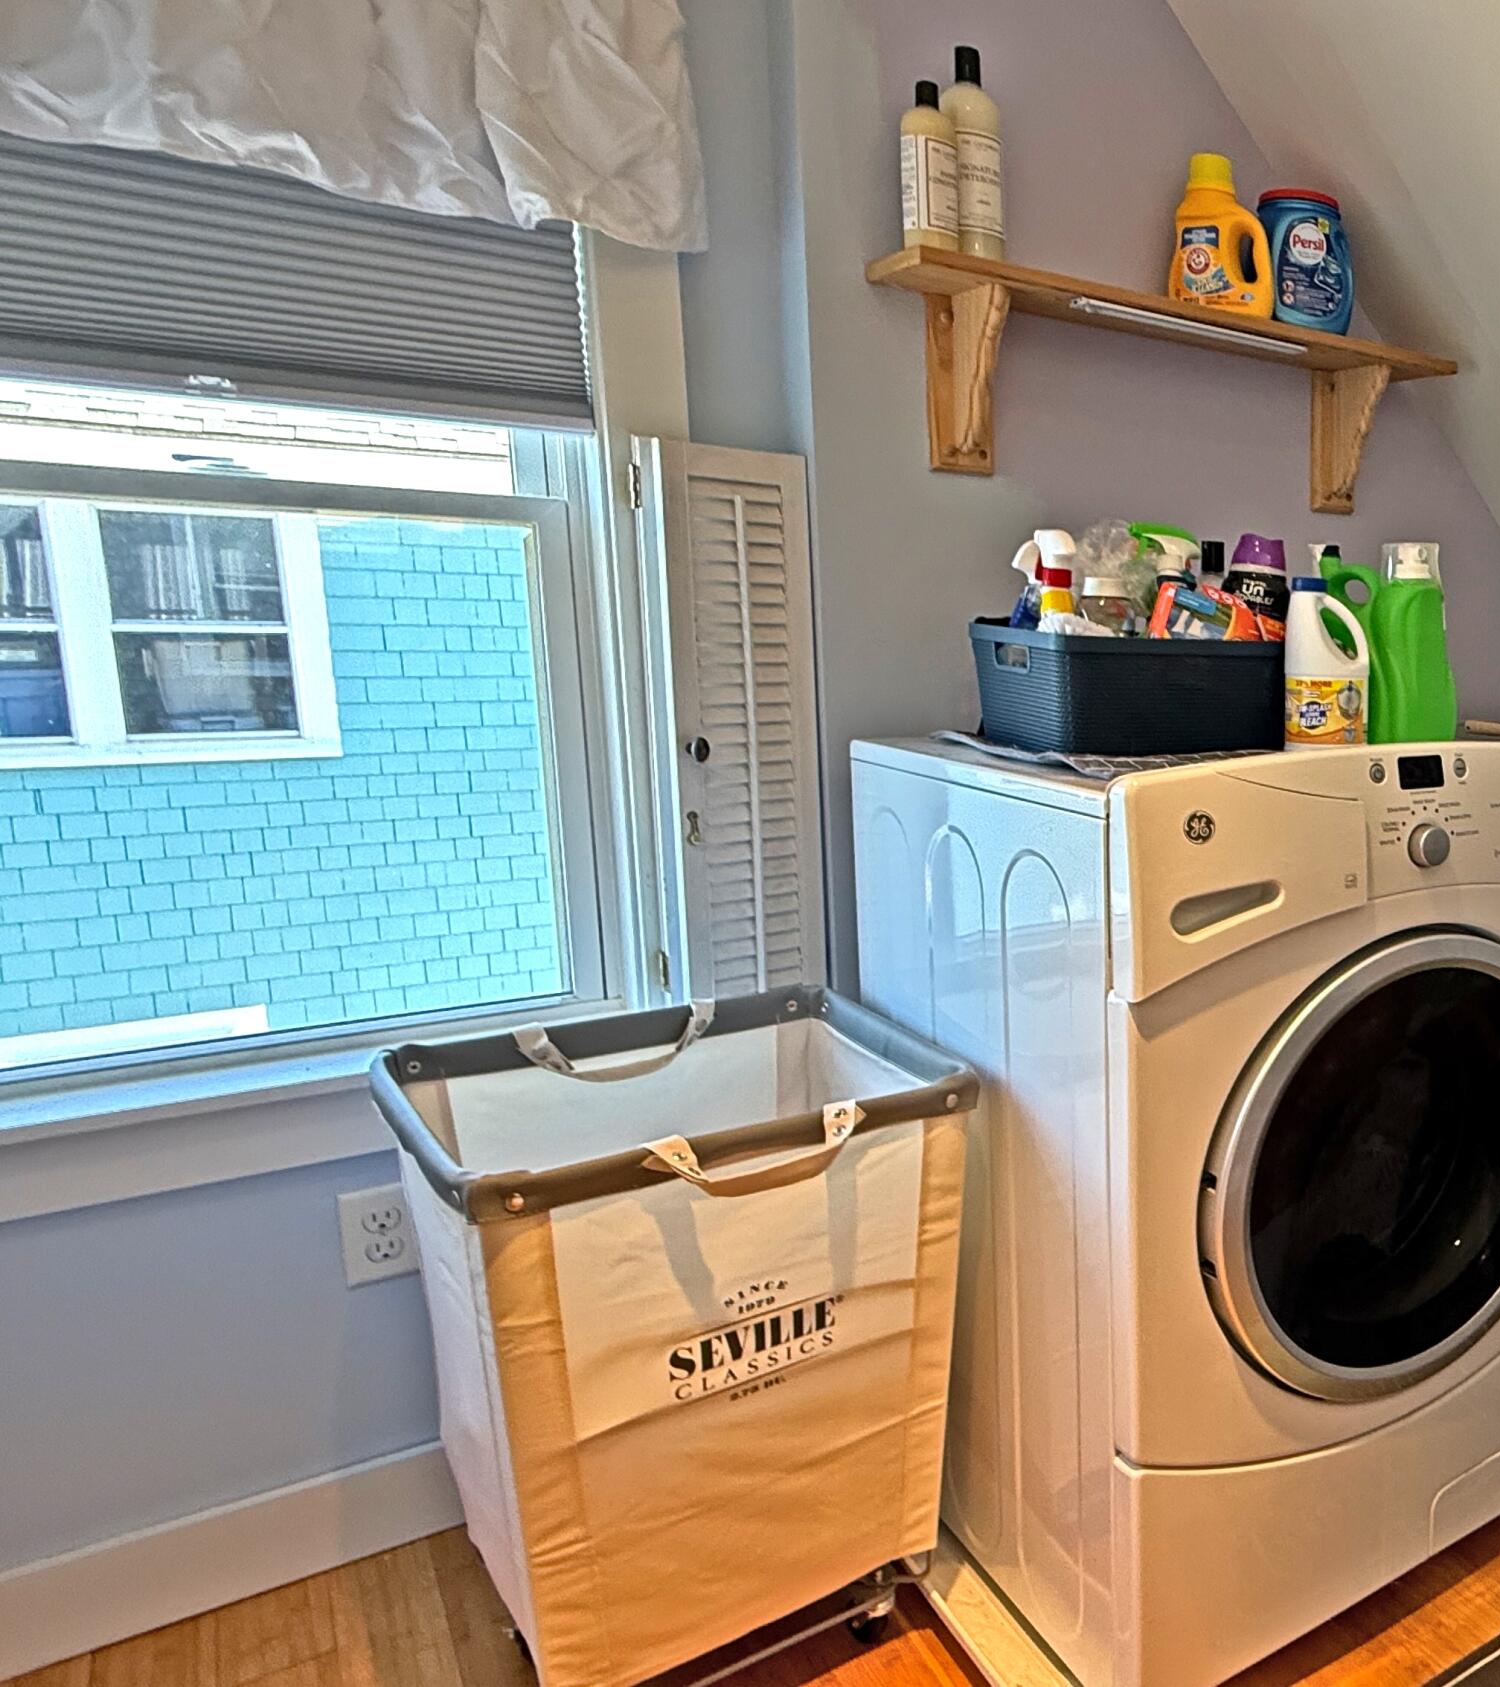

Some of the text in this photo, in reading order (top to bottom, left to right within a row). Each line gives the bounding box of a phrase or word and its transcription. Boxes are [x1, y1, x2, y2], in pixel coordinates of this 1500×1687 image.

[1293, 234, 1325, 252] Persil
[669, 1298, 837, 1382] SEVILLE
[675, 1331, 834, 1400] CLASSICS
